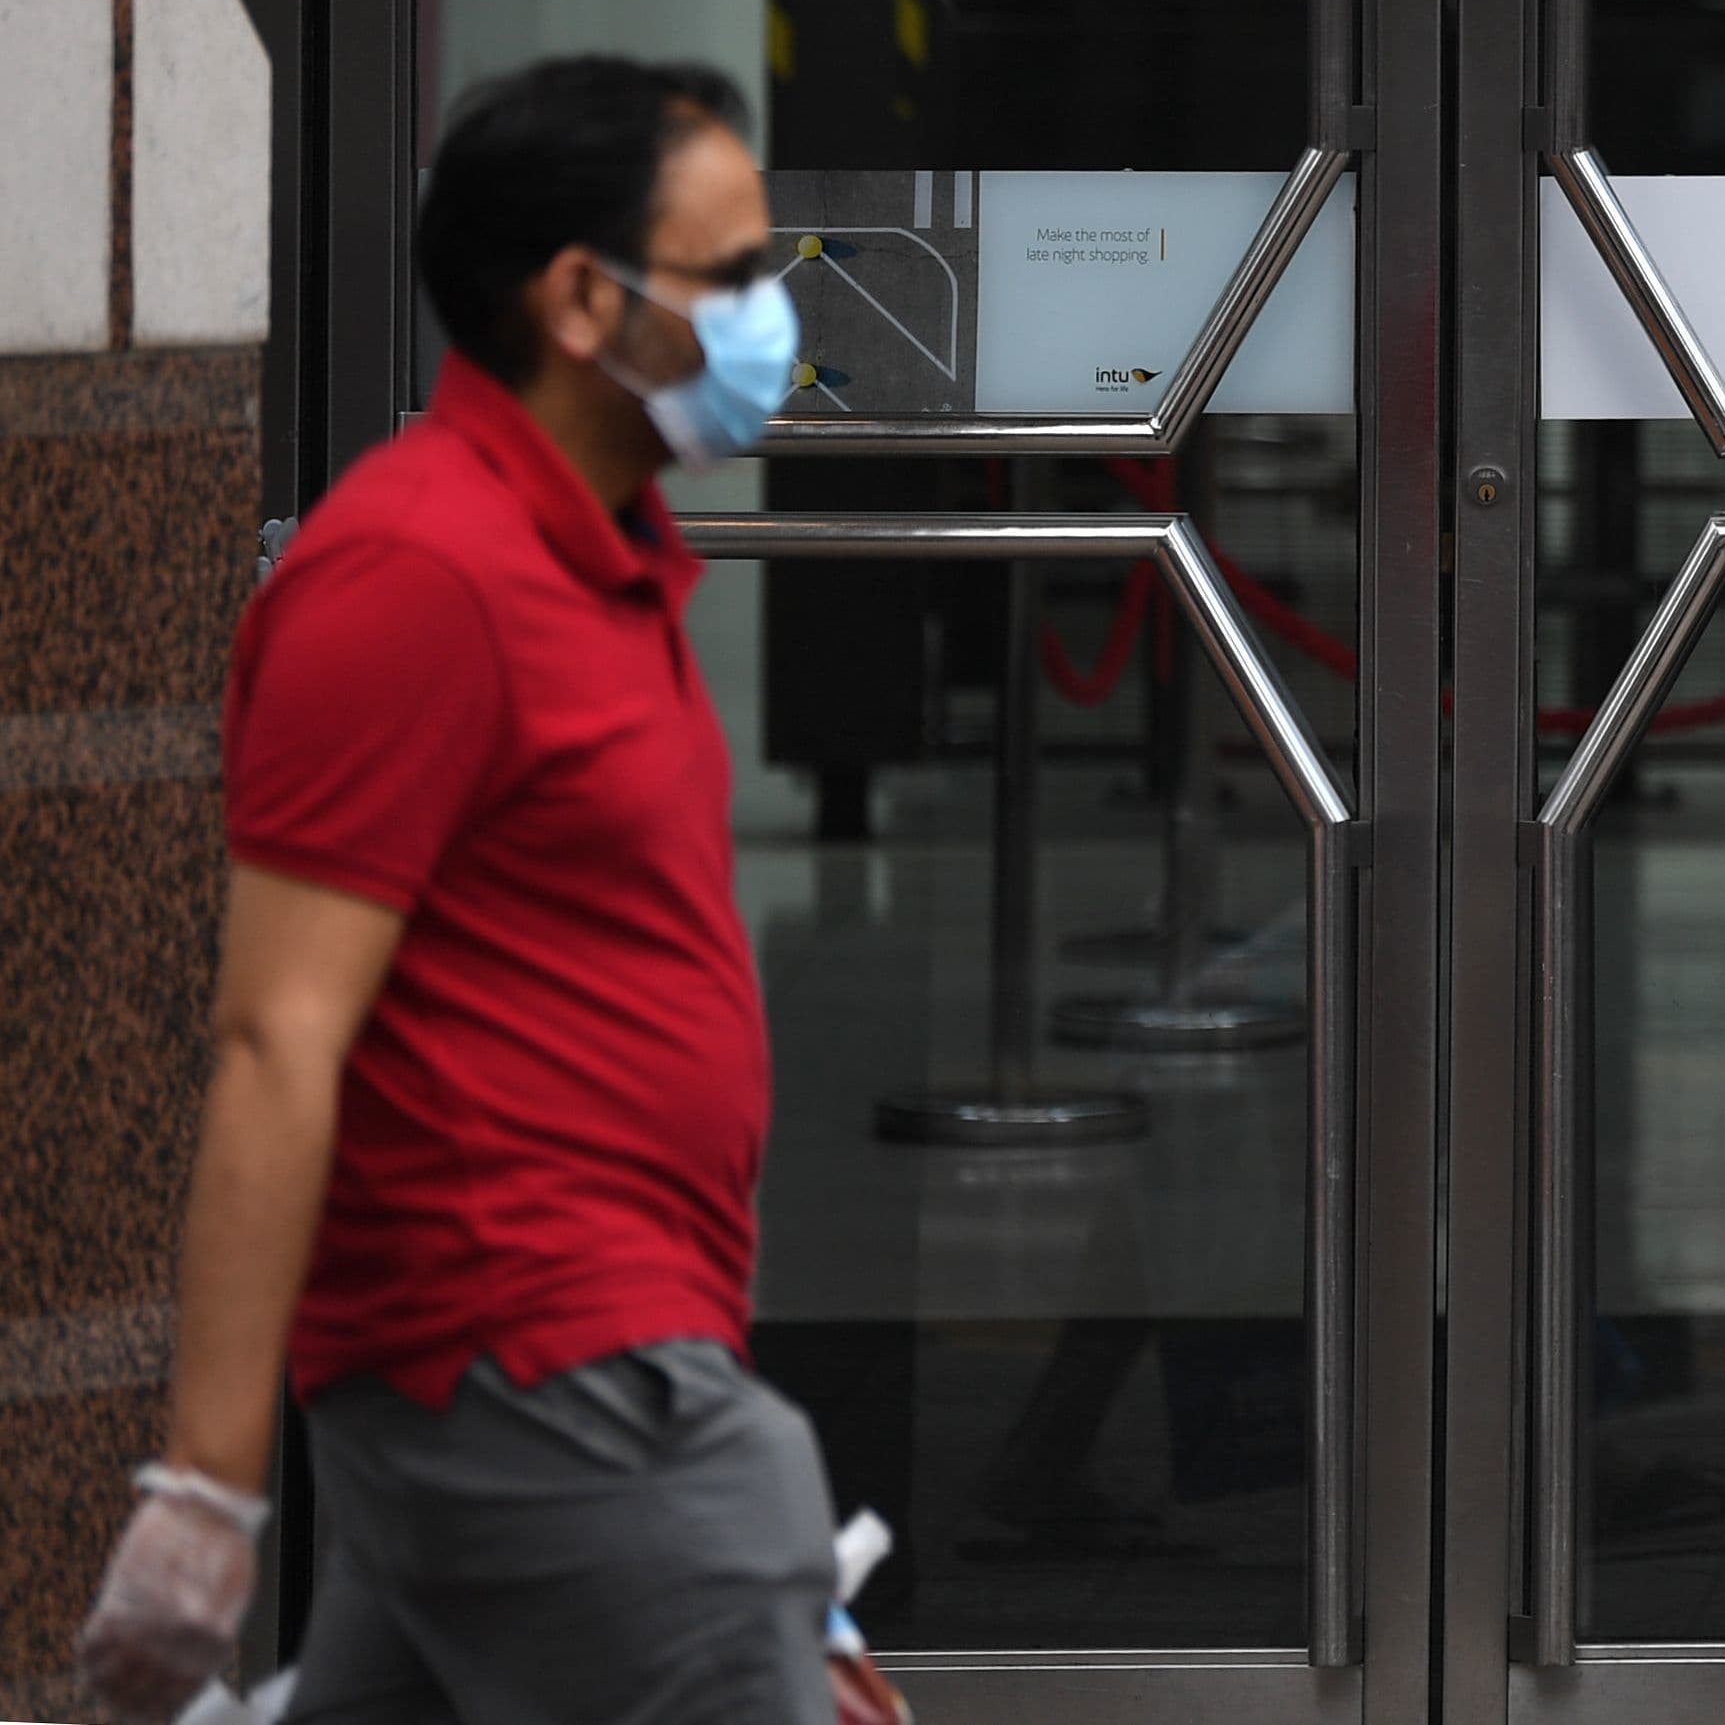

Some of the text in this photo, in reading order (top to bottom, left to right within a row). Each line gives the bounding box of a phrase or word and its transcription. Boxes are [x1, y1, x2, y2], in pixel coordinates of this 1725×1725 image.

[1036, 227, 1151, 243] Make the most of
[1026, 247, 1050, 262] late
[1052, 247, 1086, 265] night
[1095, 366, 1130, 383] intu
